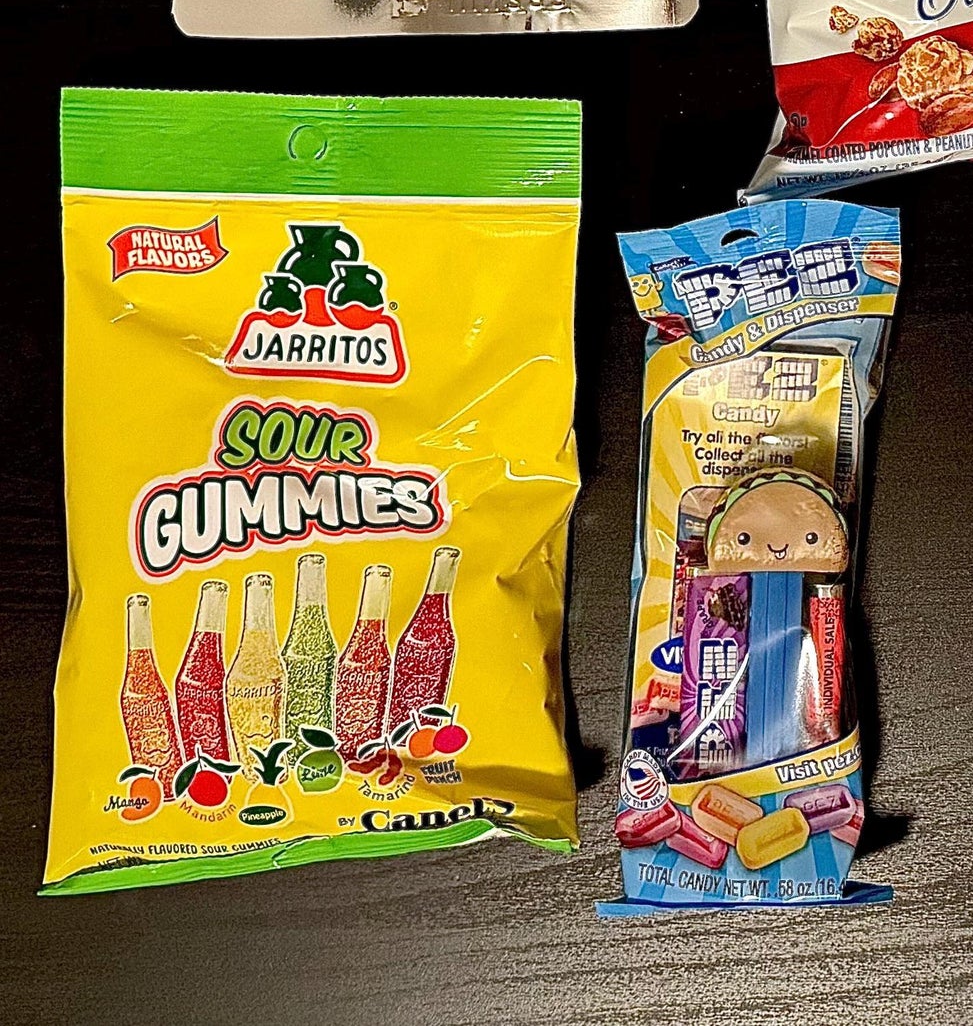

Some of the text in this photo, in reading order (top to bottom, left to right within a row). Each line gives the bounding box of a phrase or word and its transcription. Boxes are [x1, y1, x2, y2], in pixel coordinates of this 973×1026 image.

[870, 138, 920, 159] POPCORN
[131, 231, 206, 251] NATURAL
[127, 248, 215, 269] FLAVORS
[672, 238, 859, 330] PEZ
[691, 298, 859, 363] Candy Dispenser
[242, 333, 388, 367] JARRITOS
[712, 402, 780, 427] Candy
[221, 408, 364, 465] SOUR
[682, 430, 751, 445] Try the
[694, 447, 793, 464] Collect the
[140, 472, 436, 571] GUMMIES
[823, 646, 835, 710] INDIVIDUAL
[301, 763, 337, 782] Lime
[421, 760, 455, 775] FRUIT
[425, 772, 462, 784] PUNCH
[775, 759, 821, 783] Visit
[358, 774, 415, 801] Tamarind
[104, 796, 149, 812] Mango
[180, 801, 236, 822] Mandarin
[242, 809, 284, 821] Pineapple
[149, 838, 280, 855] FLAVORED SOUR GUMMIES
[639, 863, 746, 897] TOTAL CANDY NET
